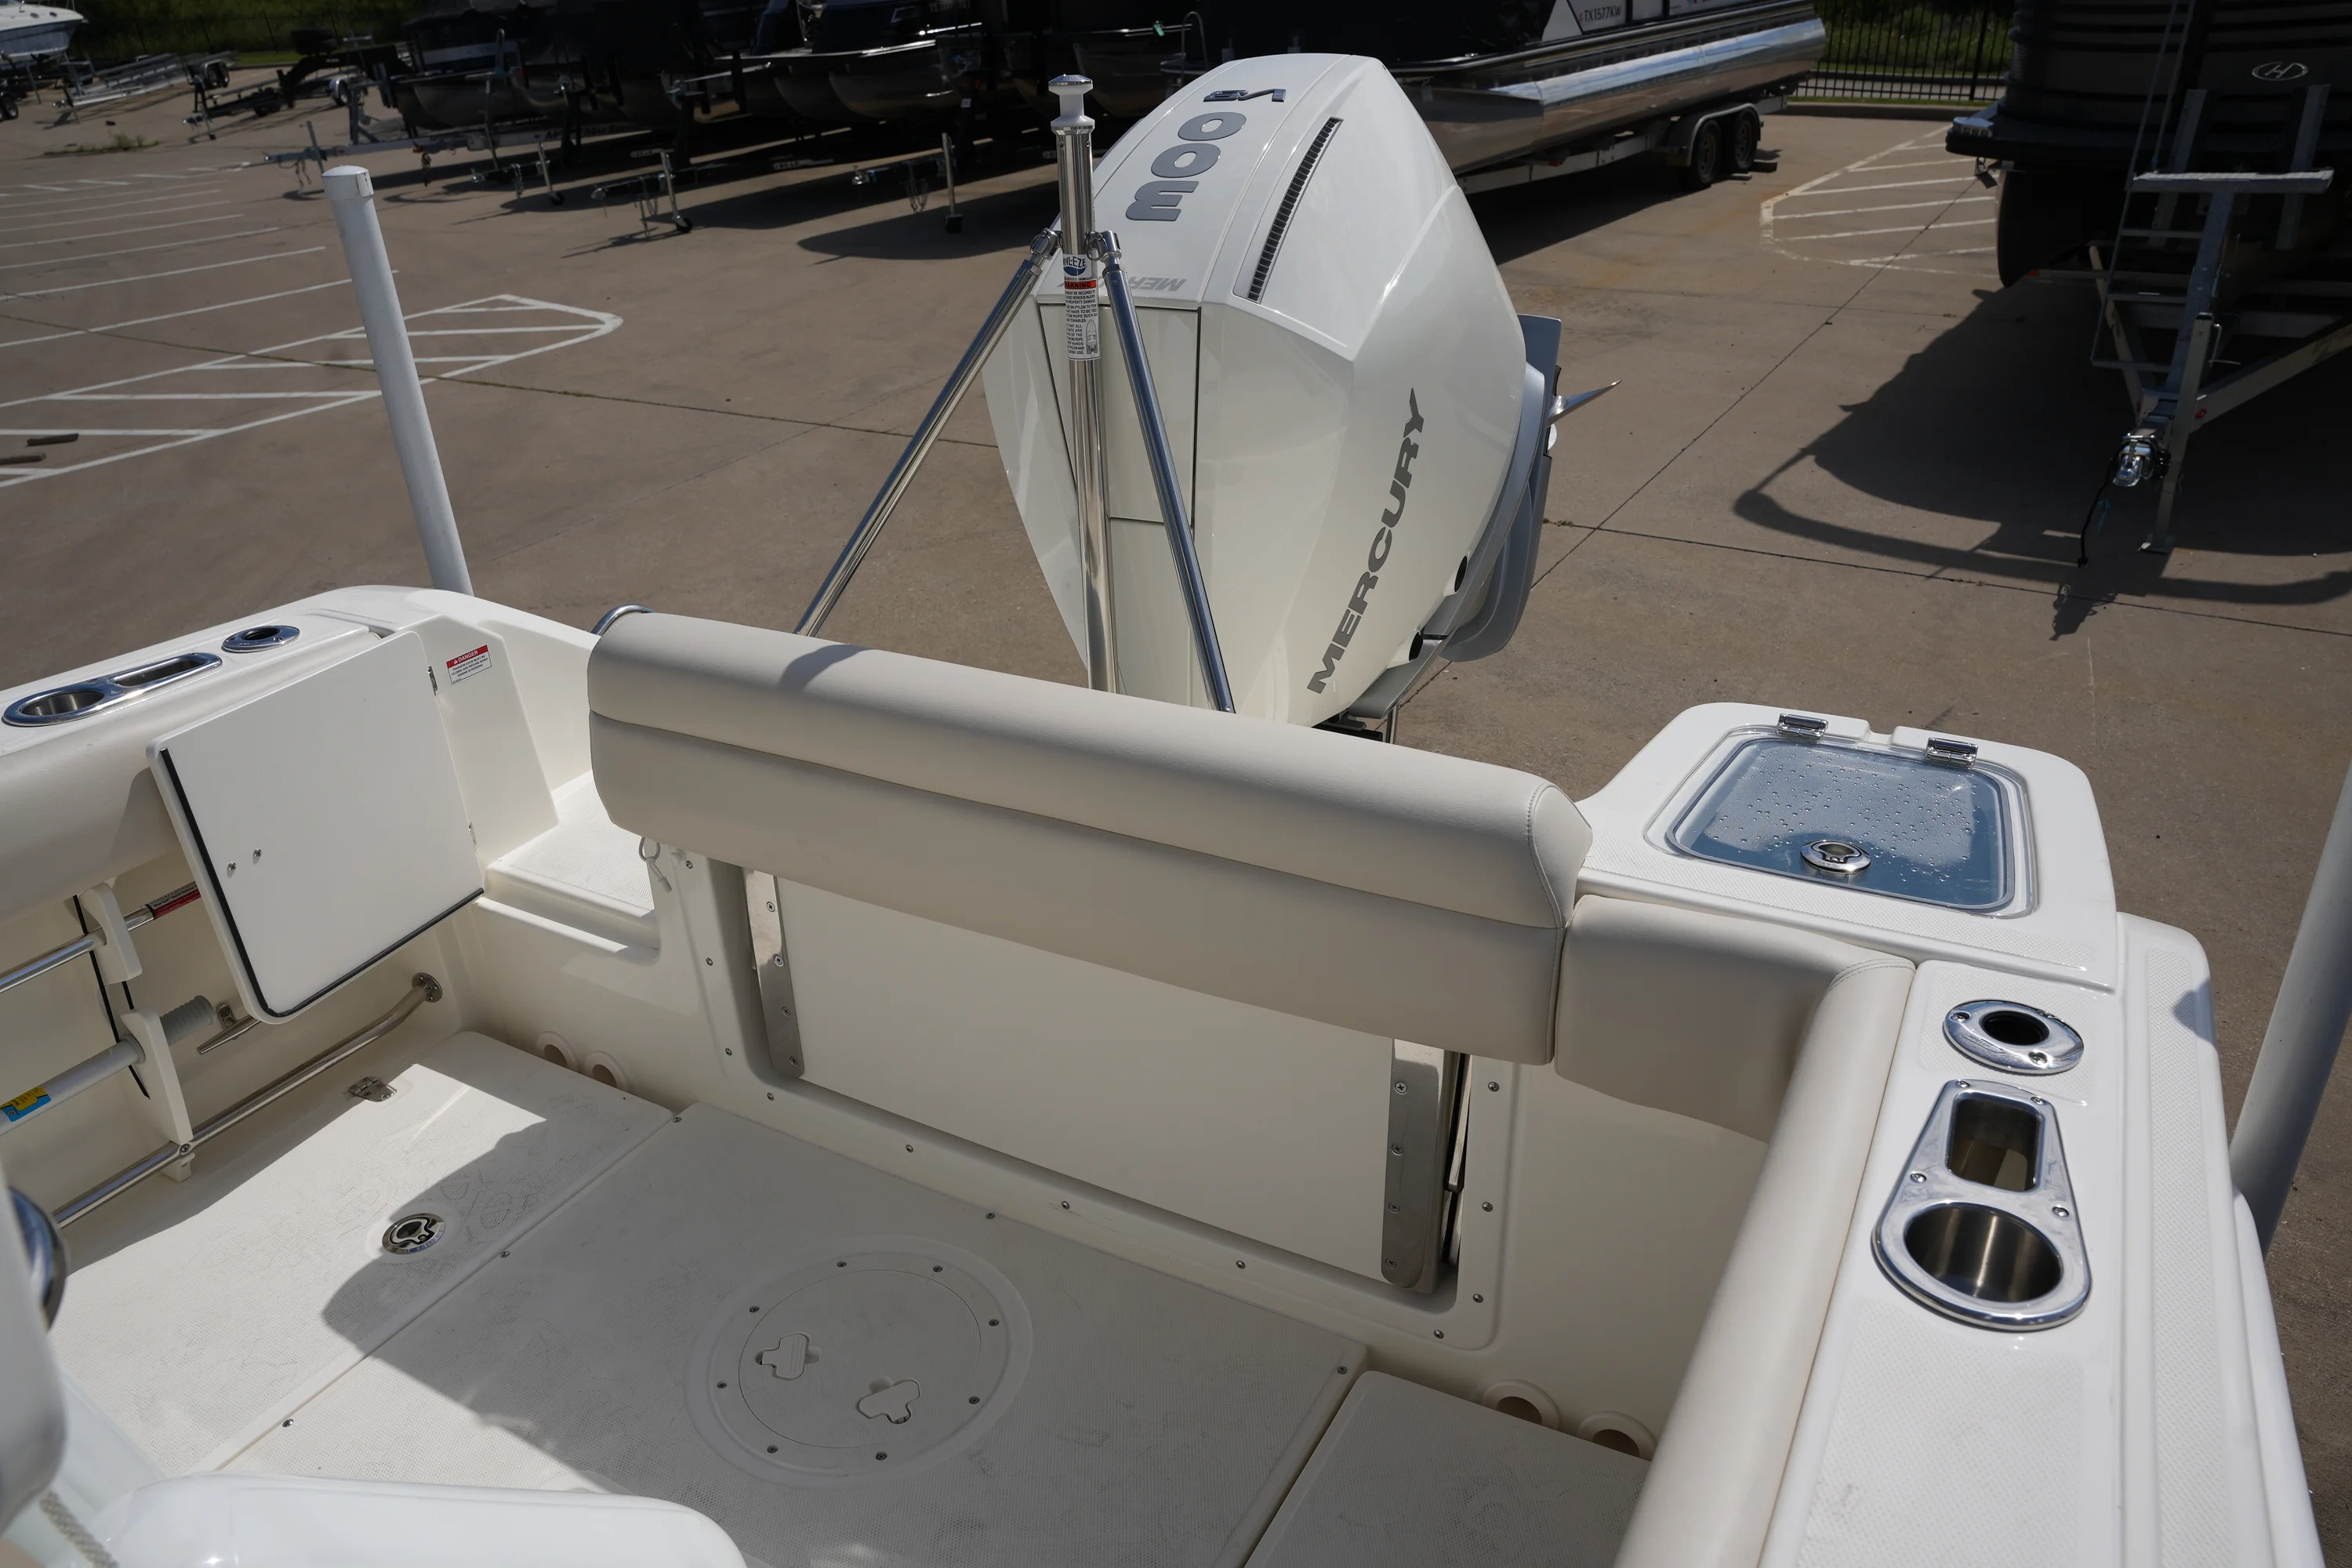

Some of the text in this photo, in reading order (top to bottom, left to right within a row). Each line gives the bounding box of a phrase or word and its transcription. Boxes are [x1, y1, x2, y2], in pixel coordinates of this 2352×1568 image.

[1125, 111, 1247, 222] 300
[1306, 387, 1425, 695] MERCURY
[458, 650, 478, 662] DANGER
